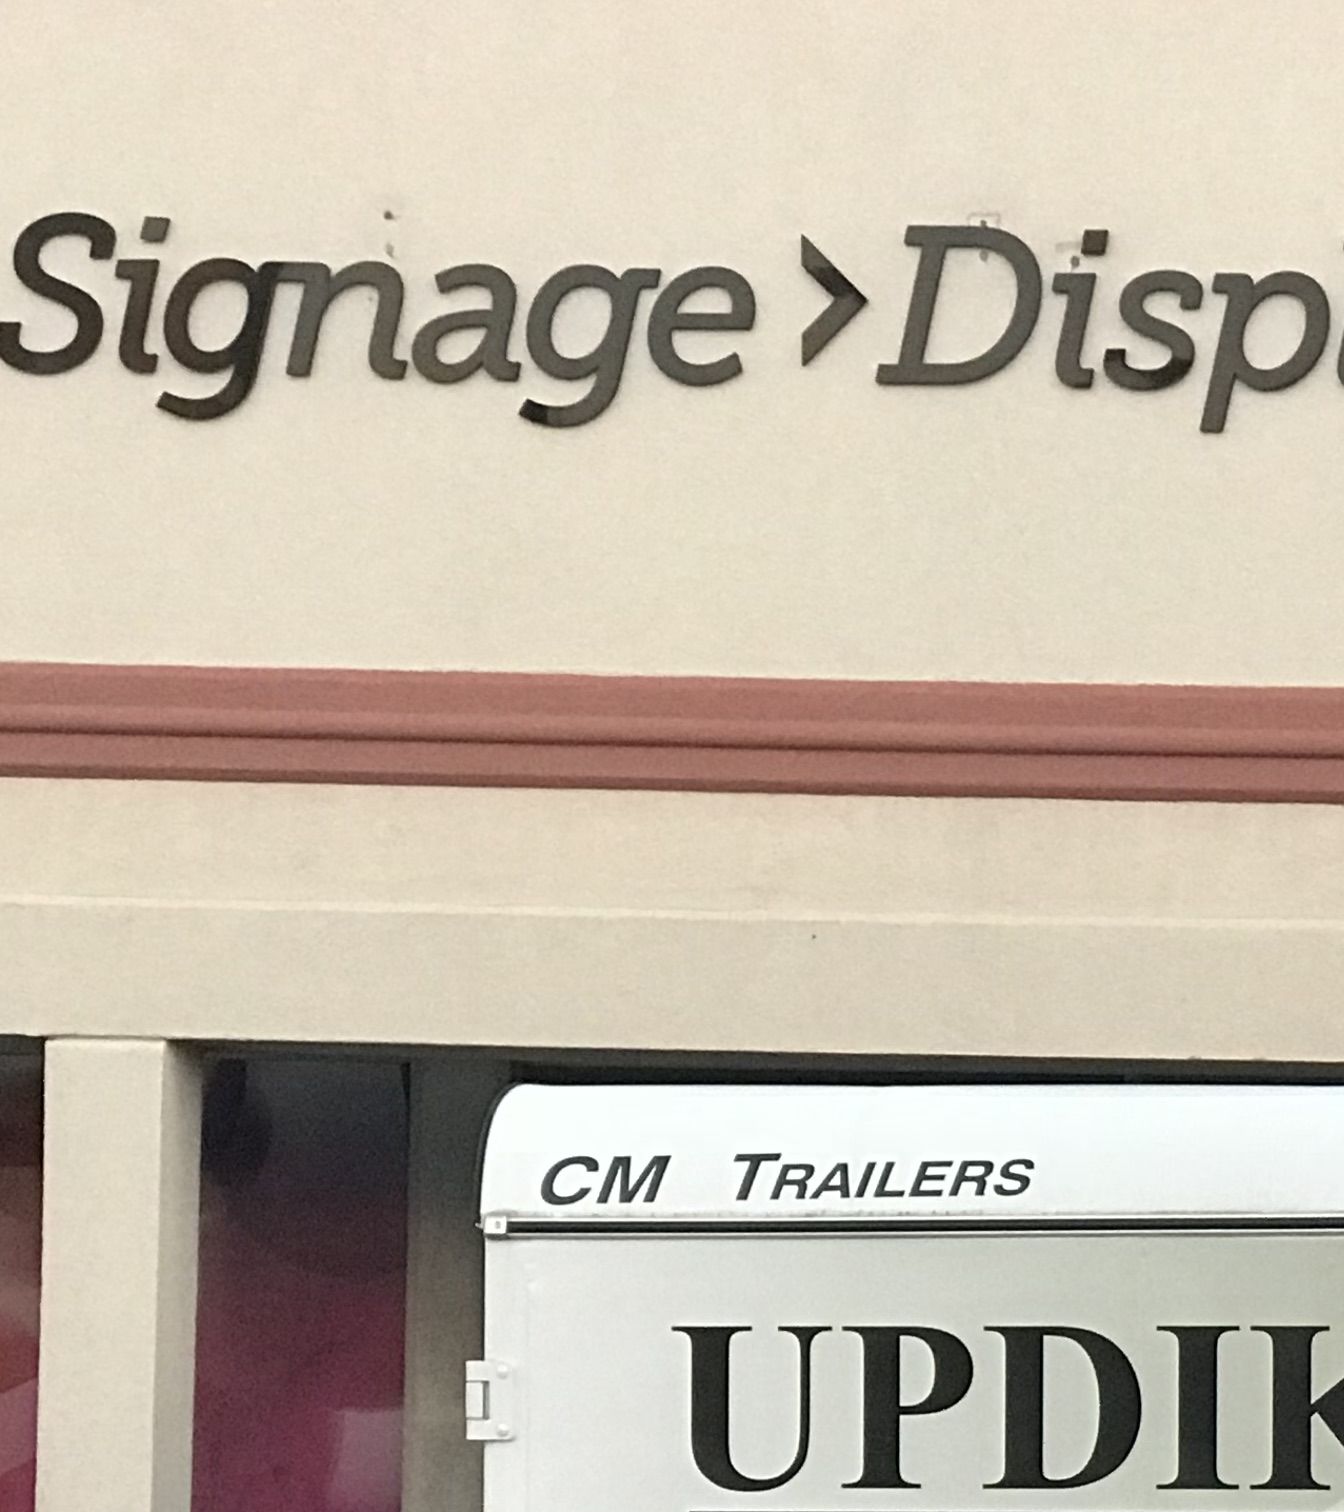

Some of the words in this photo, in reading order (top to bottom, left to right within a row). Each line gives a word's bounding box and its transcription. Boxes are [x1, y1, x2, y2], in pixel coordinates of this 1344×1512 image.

[0, 211, 757, 428] Signage
[540, 1154, 672, 1206] CM
[732, 1152, 1035, 1201] TRAILERS
